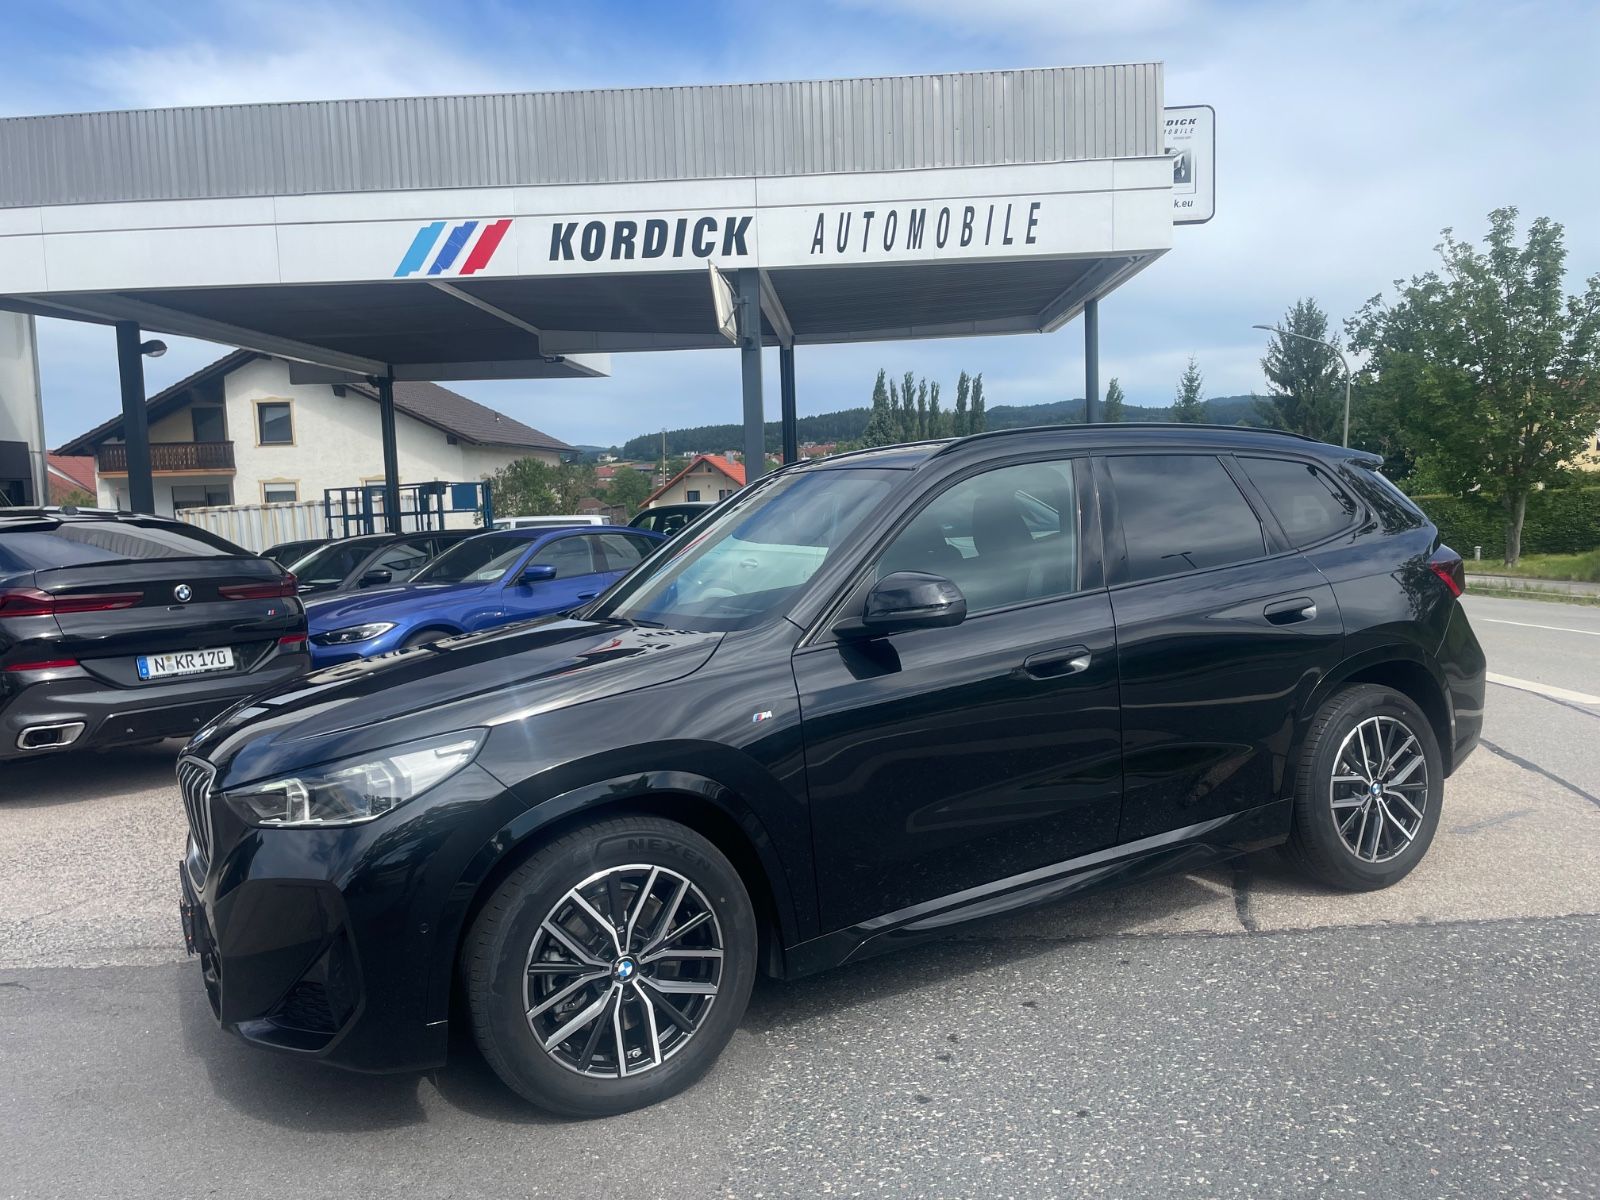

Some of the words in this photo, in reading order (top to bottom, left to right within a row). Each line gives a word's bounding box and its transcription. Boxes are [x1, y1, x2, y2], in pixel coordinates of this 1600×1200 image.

[1164, 118, 1197, 126] DICK
[549, 216, 753, 261] KORDICK
[811, 202, 1041, 254] AUTOMOBILE
[154, 658, 166, 672] N
[175, 653, 197, 670] KR
[198, 650, 227, 667] 170
[628, 839, 711, 870] NEXEN
